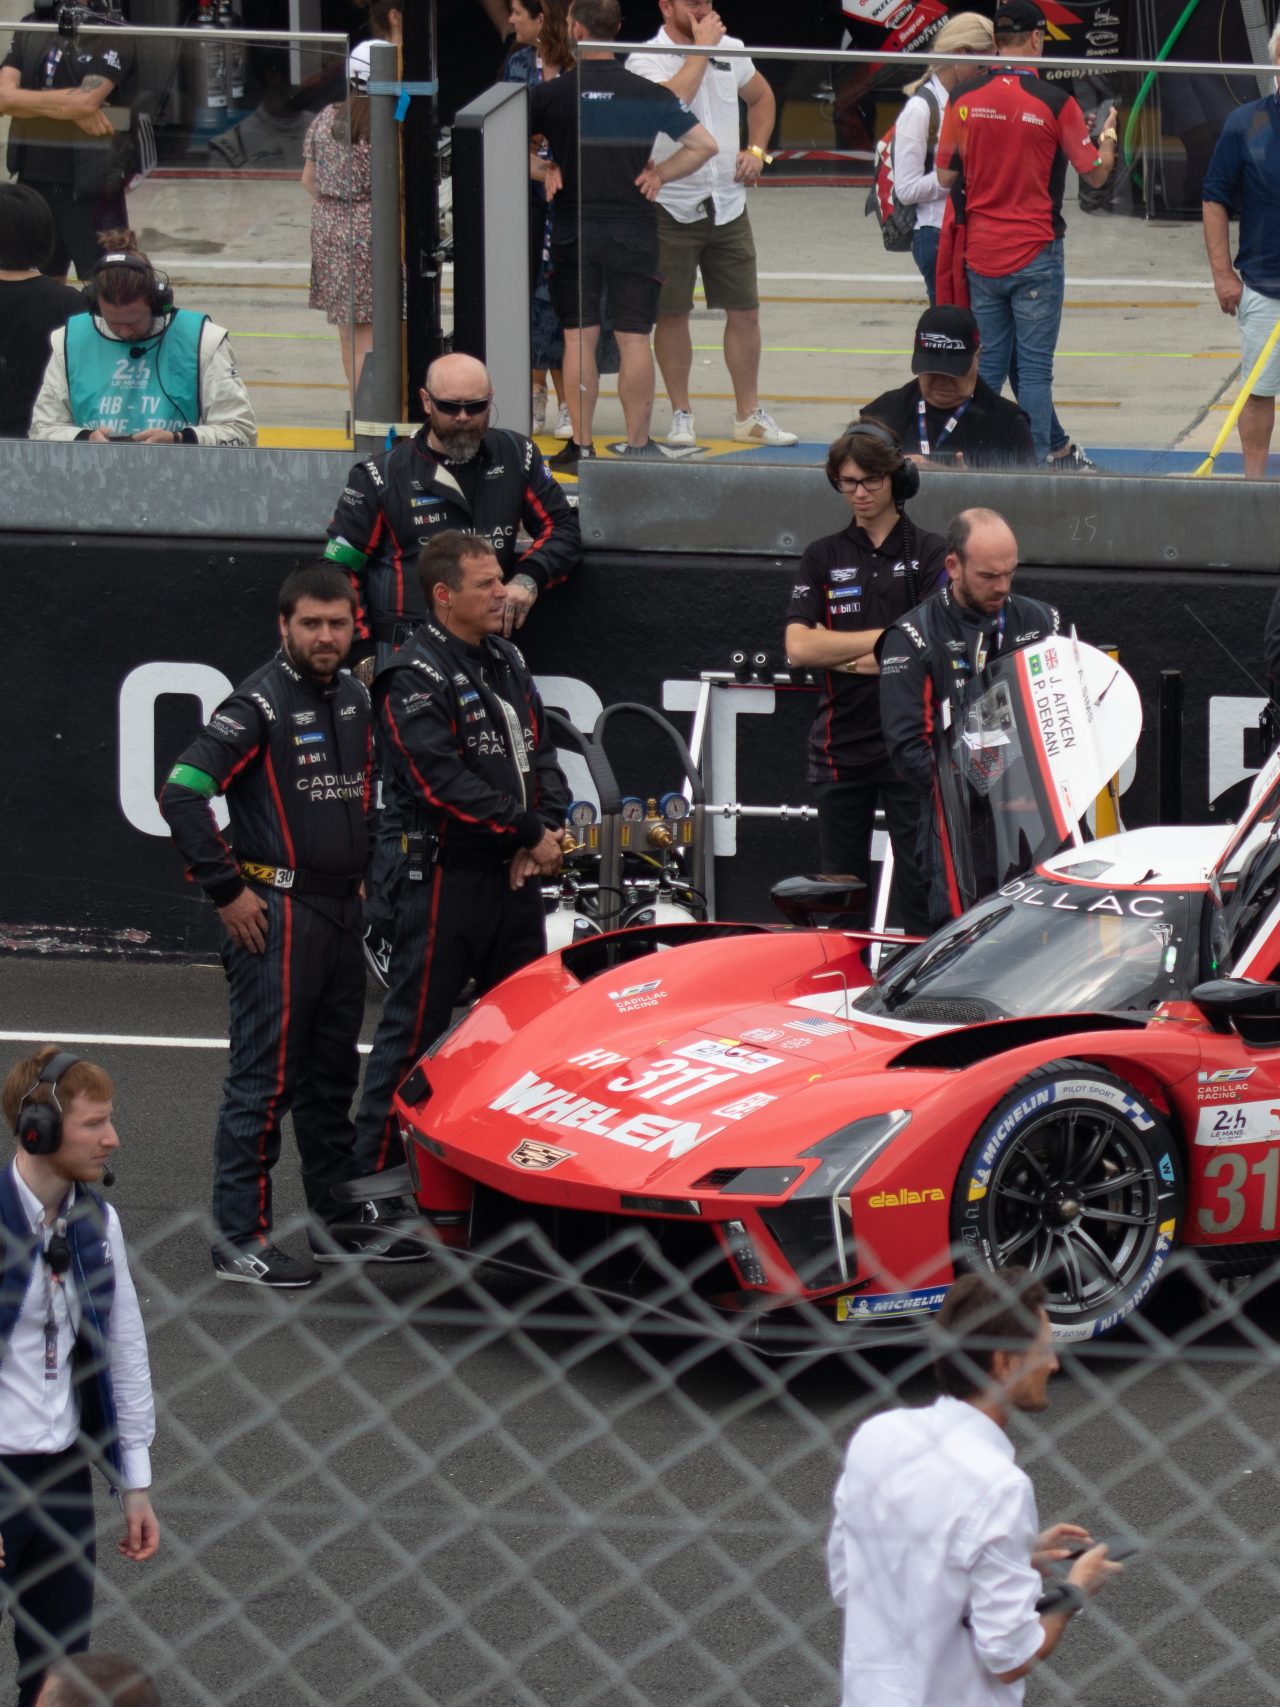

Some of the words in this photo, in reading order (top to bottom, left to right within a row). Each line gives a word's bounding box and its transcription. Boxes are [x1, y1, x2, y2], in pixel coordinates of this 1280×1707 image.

[100, 396, 122, 414] HB
[140, 396, 160, 414] TV
[414, 513, 440, 525] Mobil
[902, 622, 926, 649] HRX
[1034, 680, 1046, 694] P.
[1050, 676, 1062, 689] J.
[1037, 696, 1060, 757] DERANI
[1053, 692, 1076, 748] AITKEN
[299, 753, 321, 765] Mobil
[278, 870, 294, 883] 30
[999, 881, 1164, 917] DILLAC
[616, 991, 668, 1008] CADILLAC
[619, 1000, 658, 1013] RACING
[568, 1048, 630, 1070] HY
[607, 1058, 739, 1105] 311
[1198, 1083, 1248, 1093] CADILLAC
[1063, 1085, 1086, 1094] PILOT
[1089, 1087, 1116, 1099] SPORT
[1197, 1091, 1236, 1100] RACING
[488, 1070, 727, 1159] WHELEN
[1214, 1108, 1247, 1131] 24h
[983, 1089, 1049, 1165] MICHELIN
[1210, 1130, 1220, 1138] LE
[1222, 1129, 1244, 1137] MANS
[869, 1188, 945, 1208] dallara
[874, 1293, 946, 1312] MICHELIN
[1100, 1255, 1163, 1332] MICHELIN
